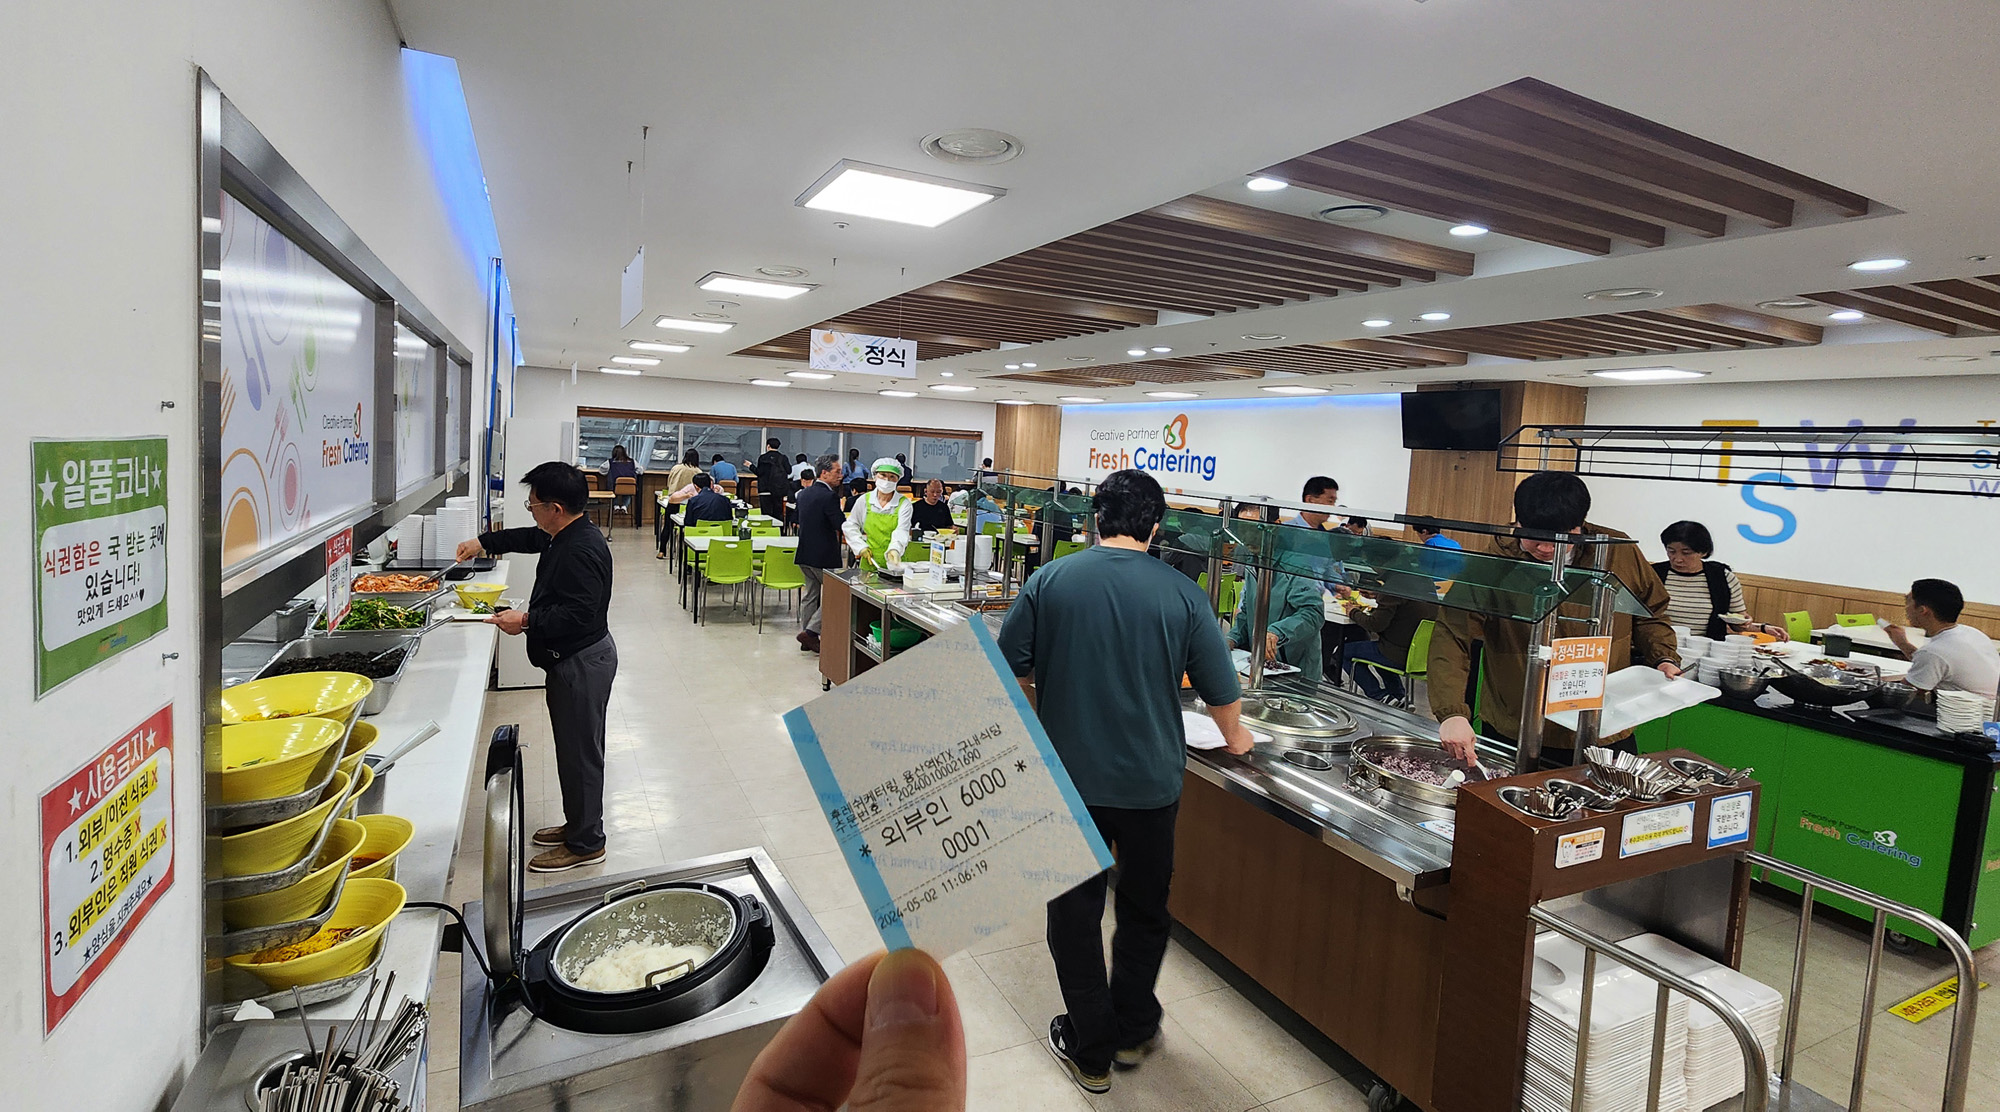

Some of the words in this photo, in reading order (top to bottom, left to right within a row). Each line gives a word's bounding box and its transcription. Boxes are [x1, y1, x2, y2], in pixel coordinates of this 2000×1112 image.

[864, 344, 906, 368] 정식
[321, 438, 341, 467] Fresh
[343, 436, 369, 465] Catering
[1090, 429, 1125, 441] Creative
[1127, 427, 1160, 441] Partner
[62, 455, 150, 509] 일품코너
[1089, 447, 1130, 470] Fresh
[1134, 447, 1217, 481] Catering
[44, 540, 102, 578] 식권함은
[107, 535, 121, 561] 국
[126, 531, 146, 557] 받는
[149, 523, 165, 550] 곳에
[85, 561, 141, 601] 있습니다!
[77, 601, 104, 627] 맛있게
[1558, 643, 1596, 662] 정식코너
[85, 729, 144, 805] 사용금지
[130, 771, 149, 803] 식권
[831, 777, 899, 821] 후레쉬케터링
[902, 748, 955, 783] 용산역KTX
[957, 722, 1002, 754] 구내식당
[836, 803, 883, 834] 주문번호
[897, 748, 982, 802] 202400100021690
[881, 795, 953, 848] 외부인
[960, 767, 1007, 807] 6000
[120, 850, 137, 884] 직원
[140, 828, 158, 860] 식권
[941, 818, 991, 859] 0001
[1800, 816, 1841, 841] Fresh
[1845, 832, 1922, 868] Catering
[878, 888, 939, 930] 2024-05-02
[941, 859, 989, 893] 11:06:19
